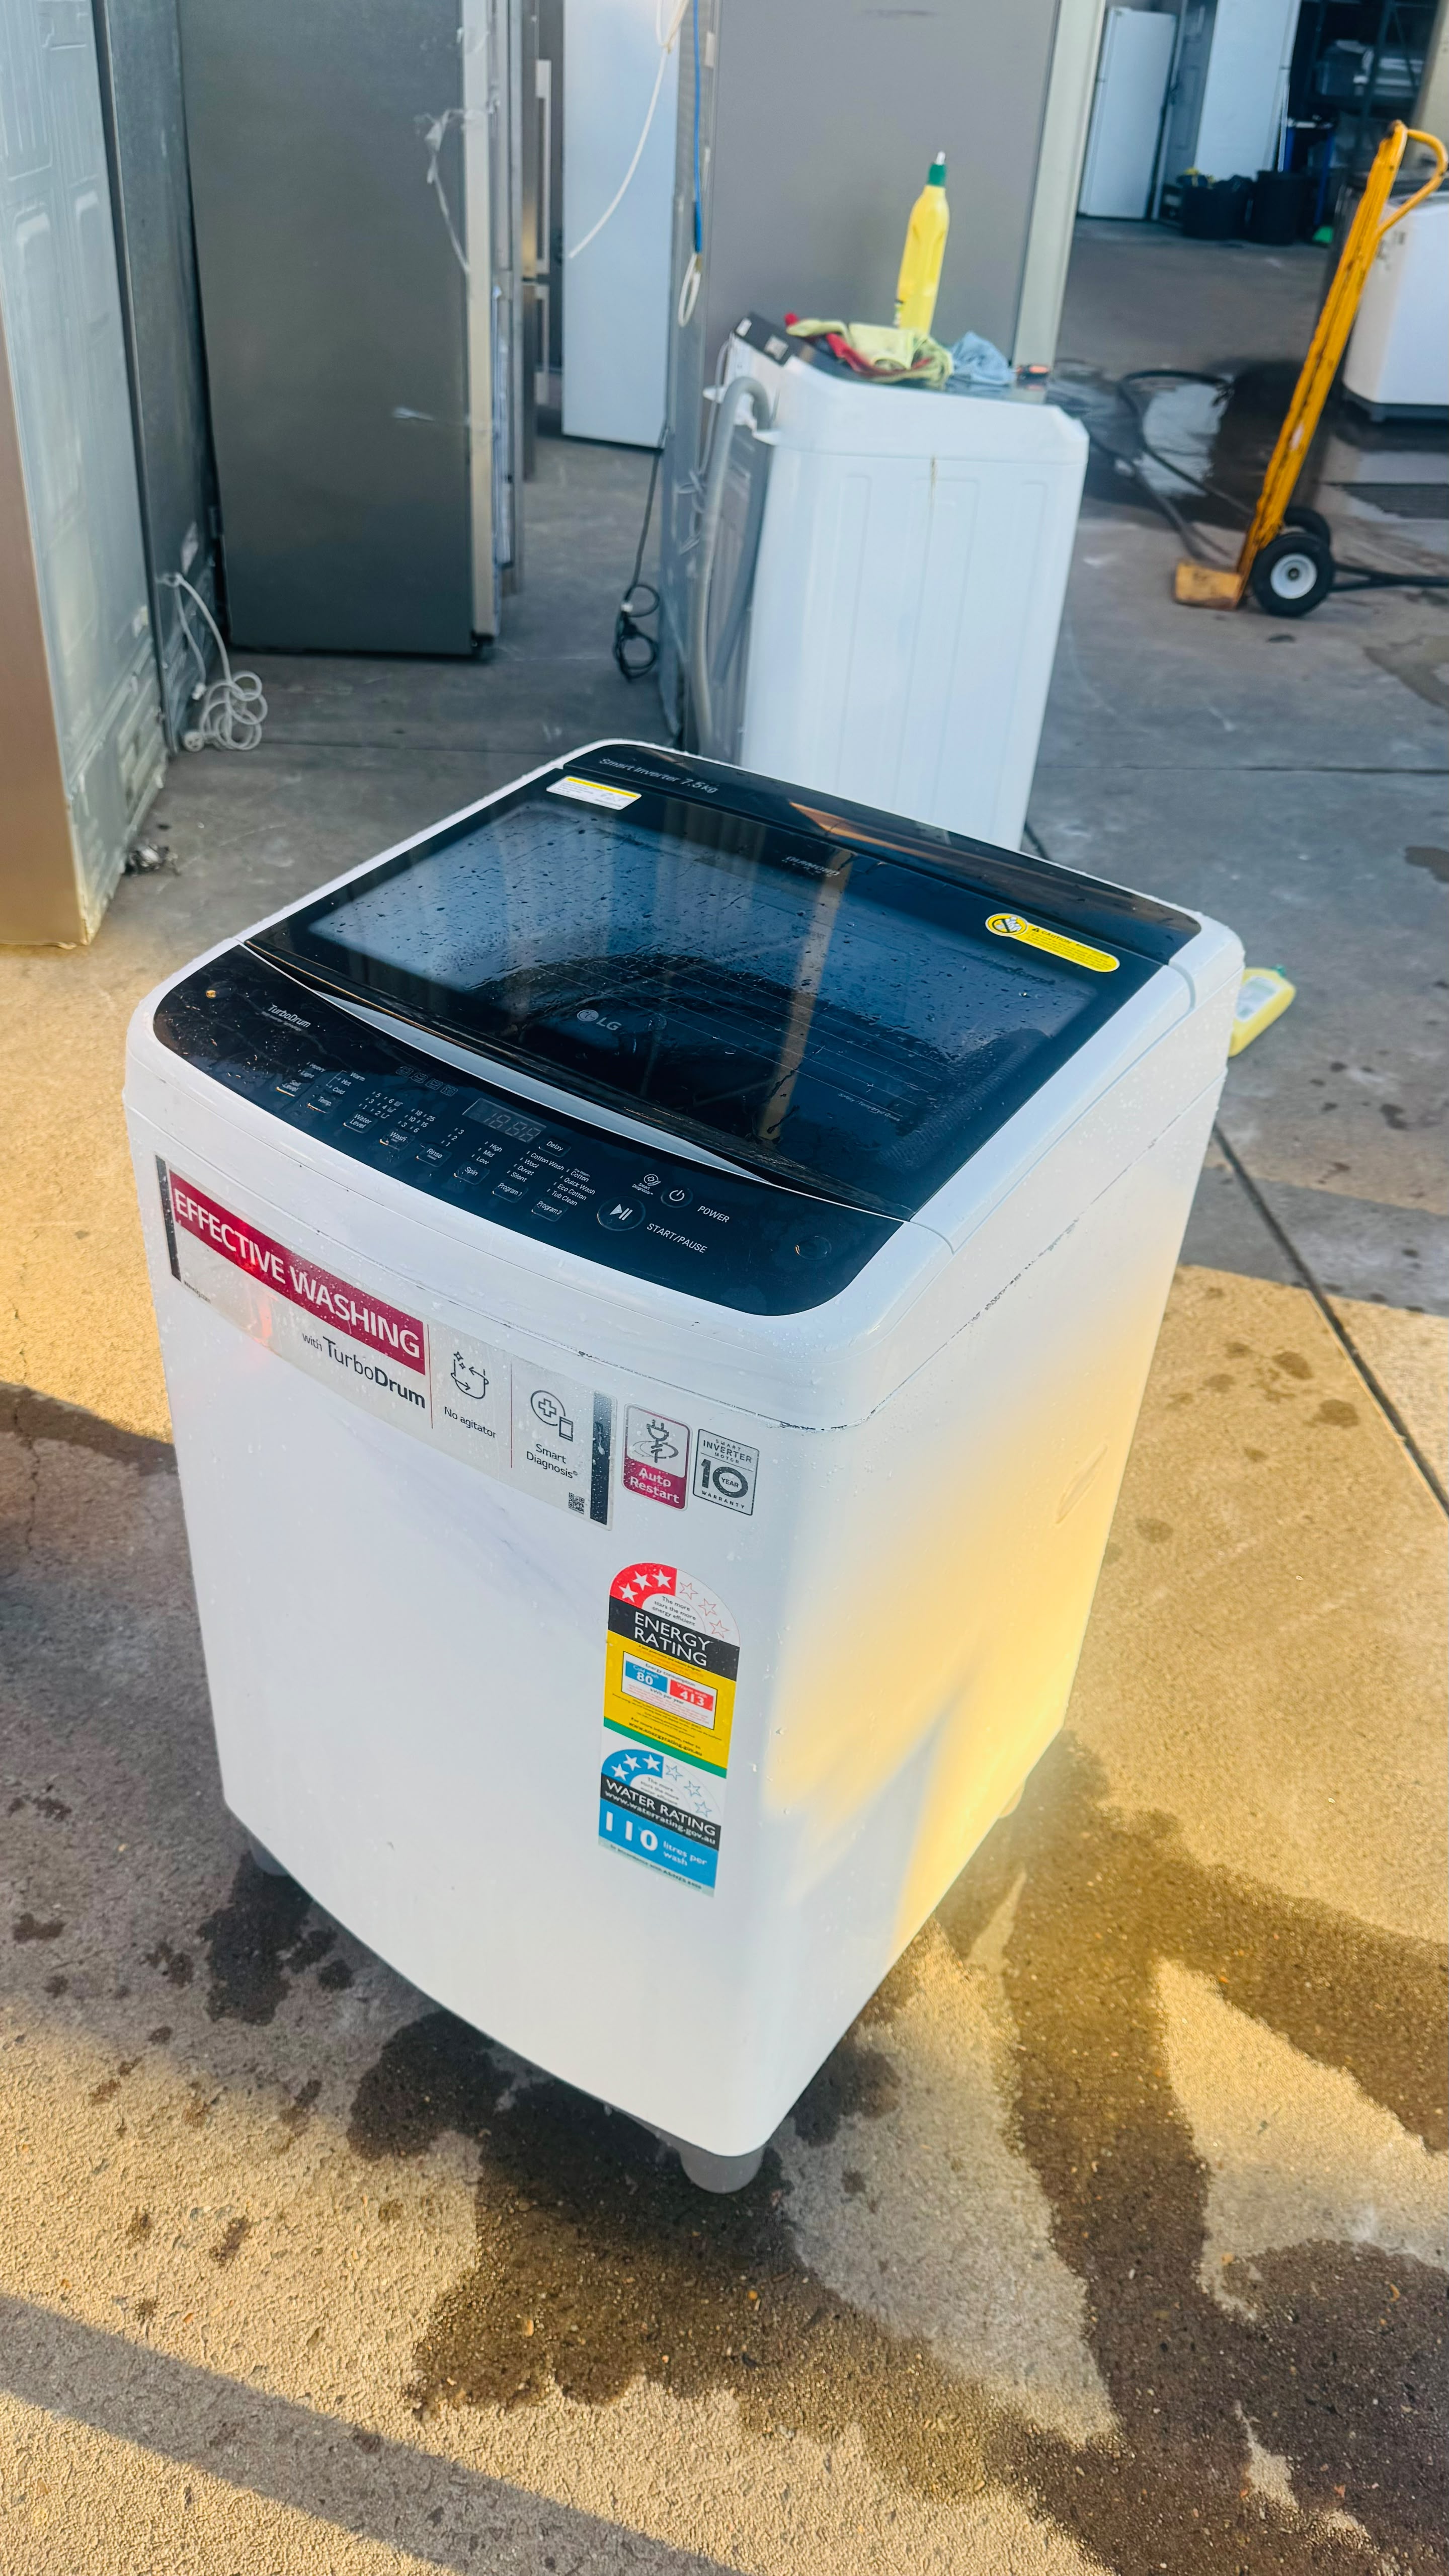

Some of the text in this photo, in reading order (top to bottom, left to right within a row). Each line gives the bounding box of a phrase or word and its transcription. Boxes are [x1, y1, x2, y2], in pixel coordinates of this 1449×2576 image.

[599, 757, 634, 772] Smart
[633, 765, 680, 782] Inverter
[1040, 930, 1072, 945] CAUTION
[268, 1002, 311, 1028] TurboDrum
[596, 1017, 622, 1031] LG
[332, 1087, 346, 1095] Cold
[350, 1118, 367, 1129] Level
[354, 1113, 372, 1124] Water
[389, 1131, 408, 1142] Wash
[426, 1148, 443, 1159] Rinse
[482, 1149, 495, 1158] Mid
[489, 1143, 503, 1152] High
[546, 1140, 564, 1152] Delay
[476, 1156, 489, 1165] Low
[524, 1158, 539, 1169] Wool
[530, 1152, 565, 1171] Cotton Wash
[464, 1166, 478, 1176] Spin
[510, 1171, 527, 1182] Silent
[517, 1165, 534, 1176] Duvet
[570, 1170, 589, 1182] Cotton
[498, 1182, 520, 1196] Program
[557, 1183, 587, 1201] Eco Cotton
[564, 1177, 596, 1195] Quick Wash
[551, 1190, 578, 1206] Tub Clean
[536, 1200, 558, 1214] Program
[697, 1205, 730, 1223] POWER
[647, 1223, 708, 1253] START/PAUSE
[174, 1188, 420, 1358] EFFECTIVE WASHING
[302, 1332, 425, 1409] with TurboDrum
[444, 1406, 497, 1438] No agitator
[703, 1439, 752, 1463] INVERTER
[715, 1438, 742, 1451] SMART
[535, 1443, 567, 1464] Smart
[714, 1452, 739, 1464] MOTOR
[638, 1467, 672, 1487] Auto
[701, 1459, 749, 1498] 10
[721, 1477, 739, 1488] YEAR
[630, 1475, 680, 1504] Restart
[701, 1490, 745, 1509] WARRANTY
[654, 1600, 696, 1620] stars the more
[662, 1596, 690, 1611] The more
[652, 1606, 695, 1626] energy efficient
[635, 1611, 710, 1651] ENERGY
[634, 1626, 707, 1666] RATING
[645, 1662, 663, 1674] Energy
[636, 1671, 653, 1685] 80
[680, 1691, 704, 1707] 413
[606, 1779, 716, 1836] WATER RATING
[604, 1790, 715, 1845] www.waterrating.gov.au
[605, 1811, 659, 1852] 110
[663, 1840, 707, 1865] litres per
[663, 1850, 688, 1866] wash
